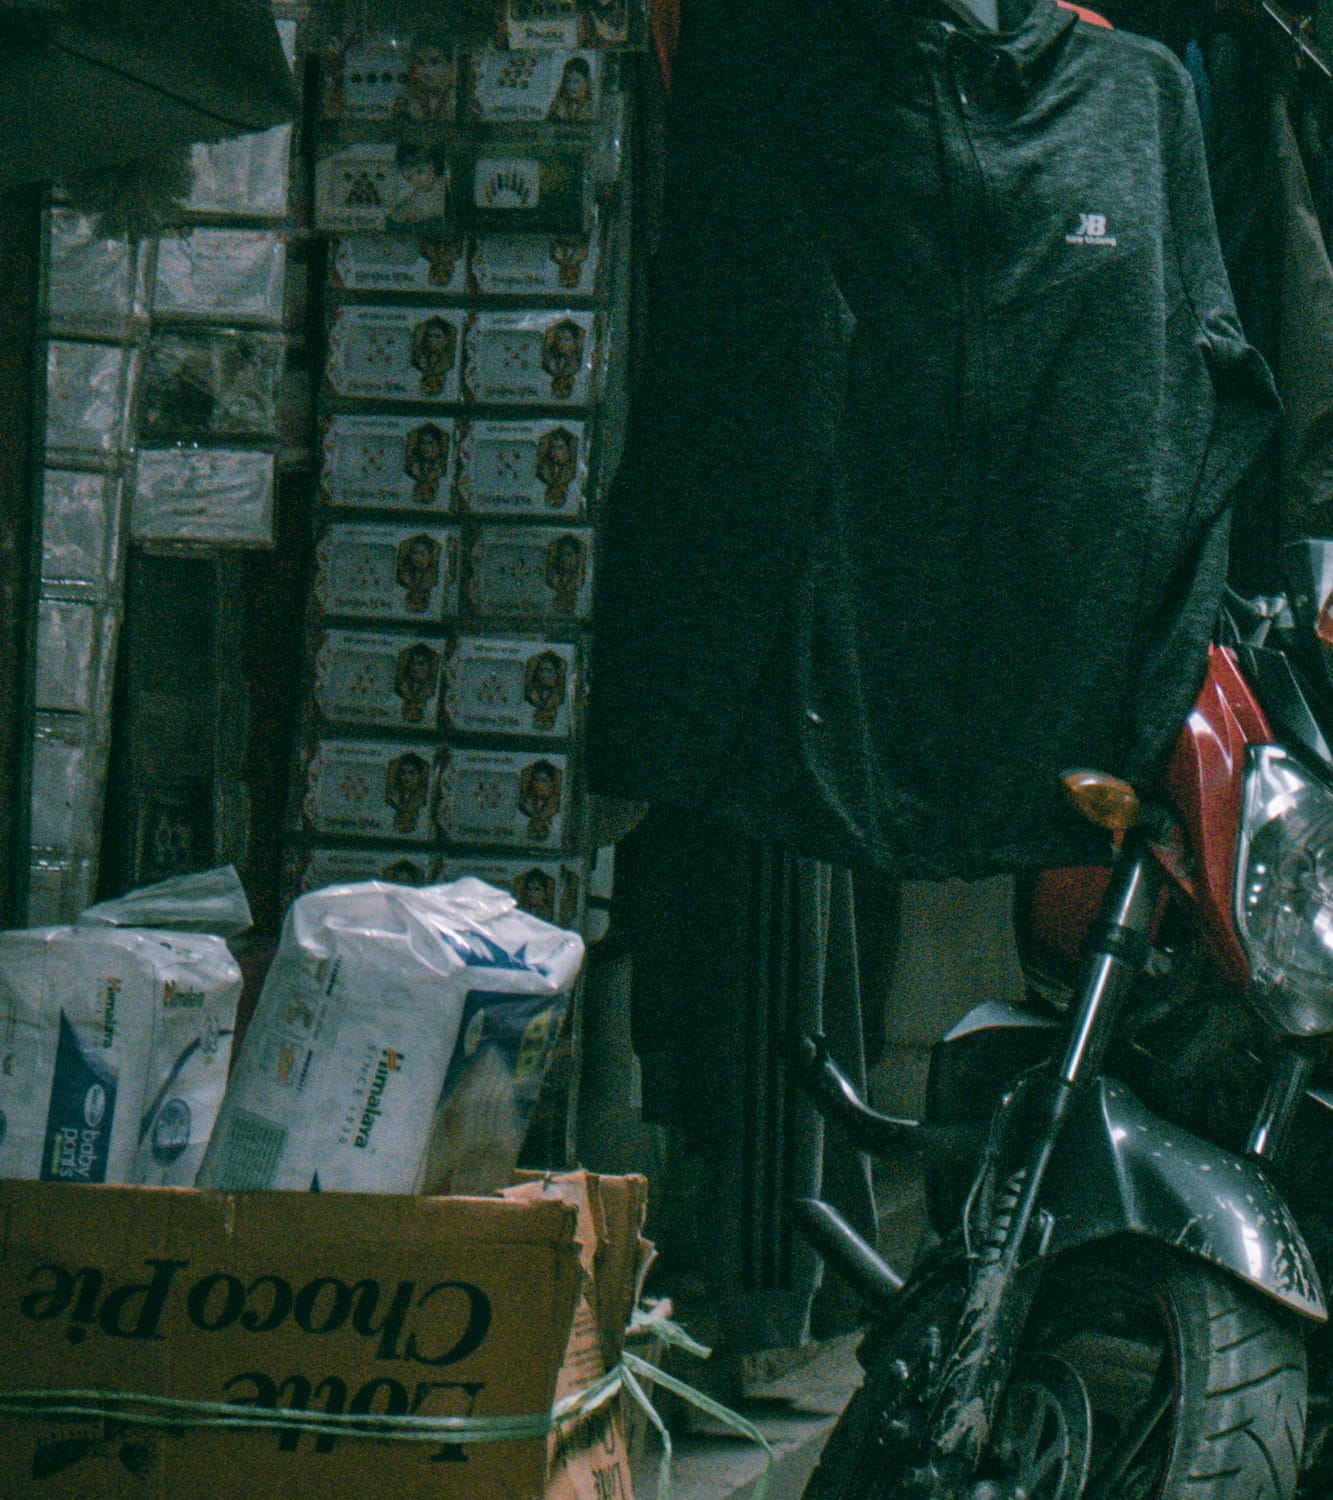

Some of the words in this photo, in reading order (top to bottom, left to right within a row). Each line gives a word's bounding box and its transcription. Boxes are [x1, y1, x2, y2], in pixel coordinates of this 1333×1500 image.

[353, 1047, 407, 1150] Himalaya
[74, 1128, 102, 1181] baby
[20, 1258, 190, 1345] Pie
[187, 1275, 491, 1368] Choco
